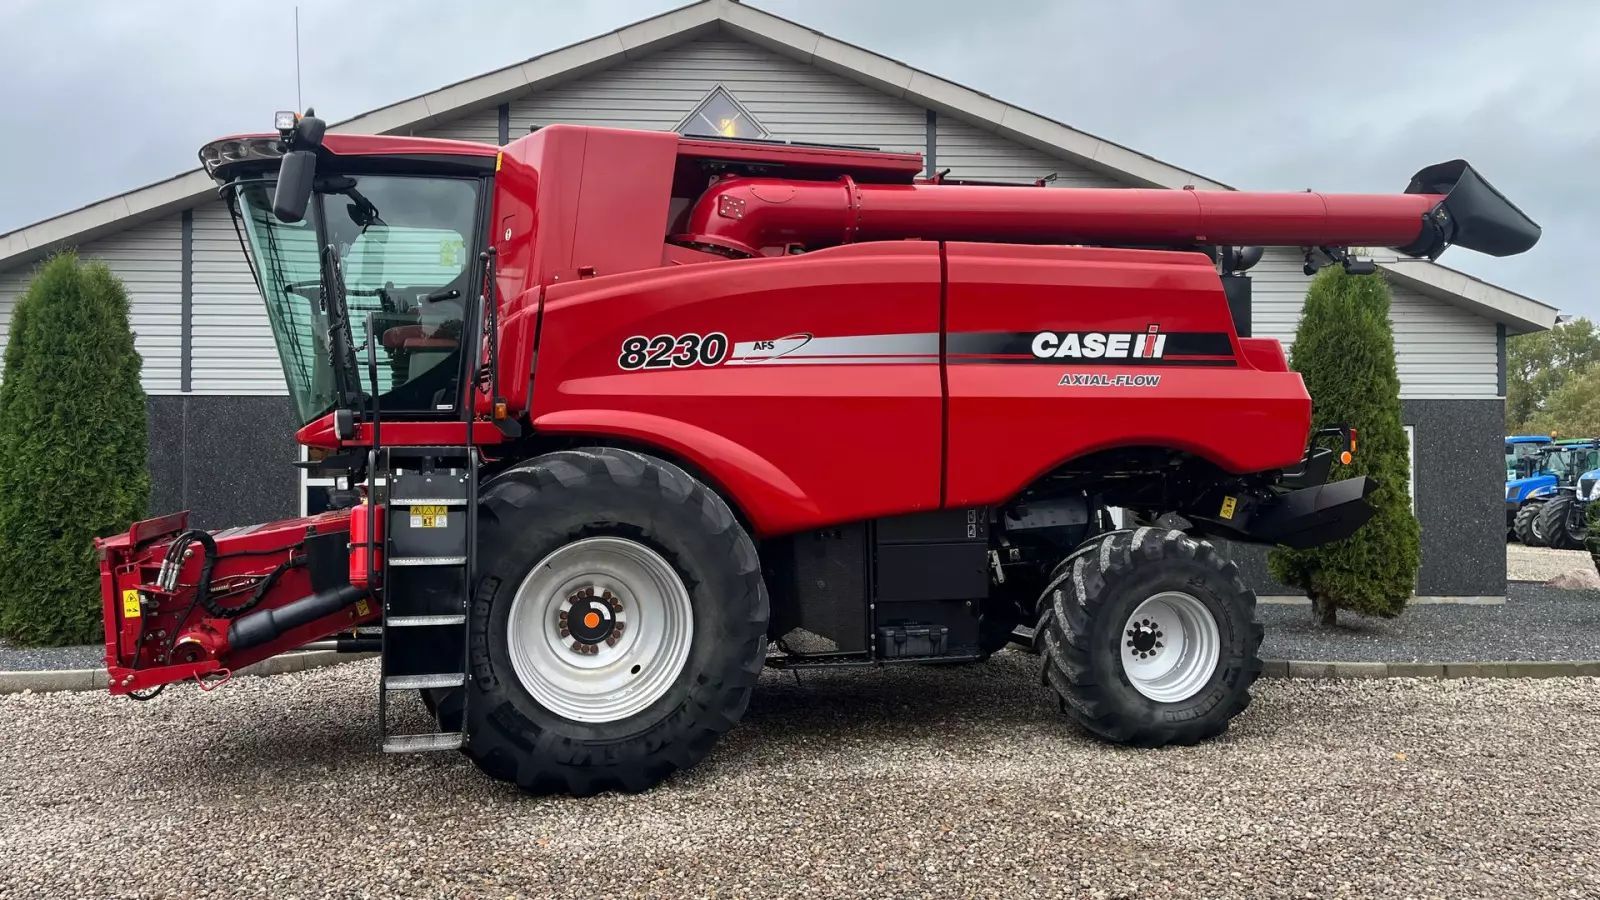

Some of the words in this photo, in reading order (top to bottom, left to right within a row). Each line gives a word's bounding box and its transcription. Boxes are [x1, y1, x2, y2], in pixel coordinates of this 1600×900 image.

[618, 332, 728, 370] 8230
[753, 341, 775, 351] AFS
[1031, 331, 1131, 358] CASE
[1058, 373, 1161, 387] AXIAL-FLOW
